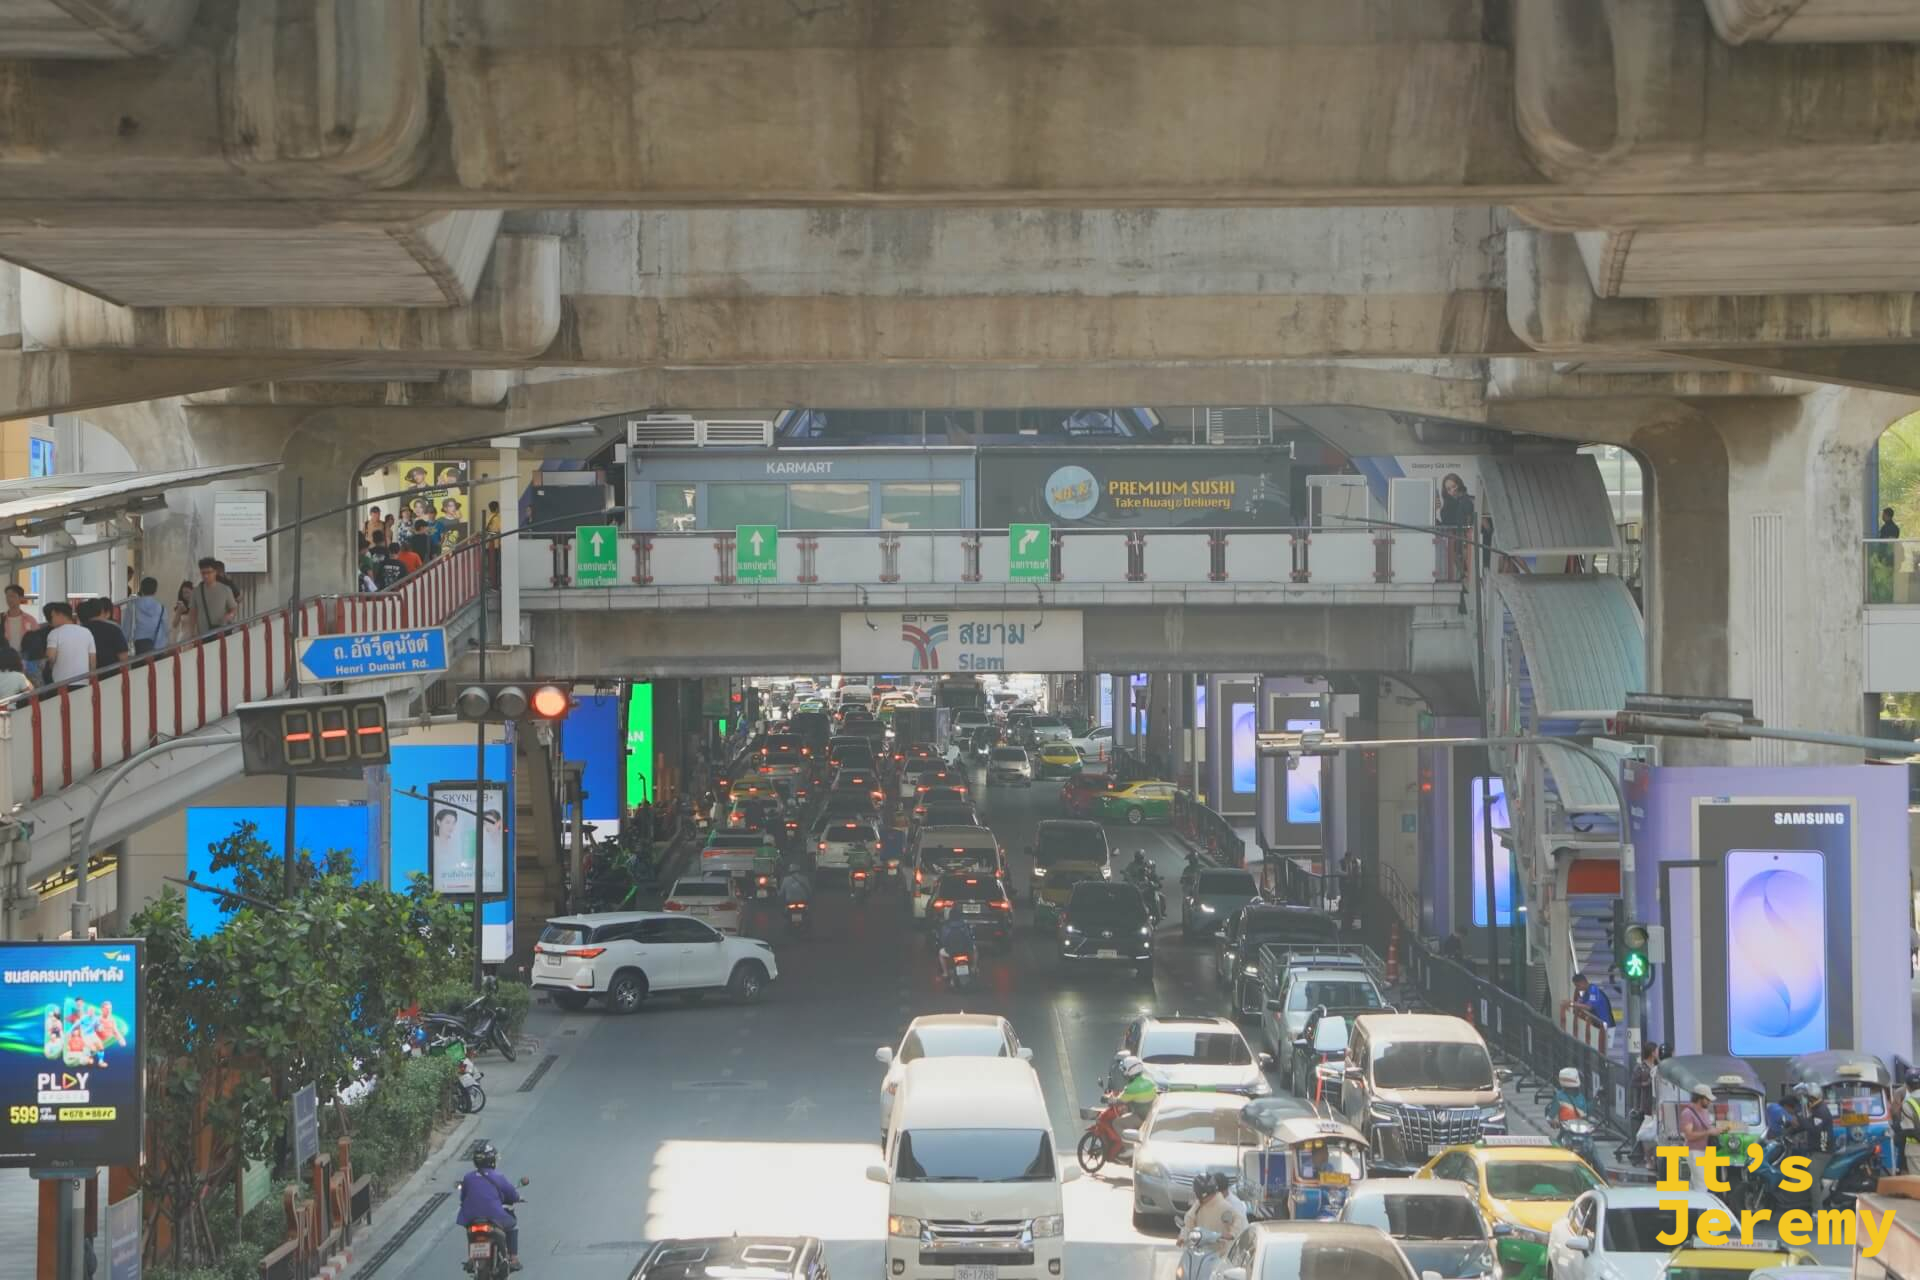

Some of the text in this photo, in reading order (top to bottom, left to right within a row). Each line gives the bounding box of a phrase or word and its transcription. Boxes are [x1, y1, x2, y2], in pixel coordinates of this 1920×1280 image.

[767, 462, 833, 473] KARMART
[1109, 480, 1235, 495] PREMIUM SUSHI
[902, 614, 948, 622] BTS
[959, 622, 1024, 644] สยาม
[336, 658, 429, 675] Henri Dunant Rd.
[958, 653, 1004, 670] Siam
[1774, 812, 1844, 825] SAMSUNG
[10, 1106, 39, 1123] 599
